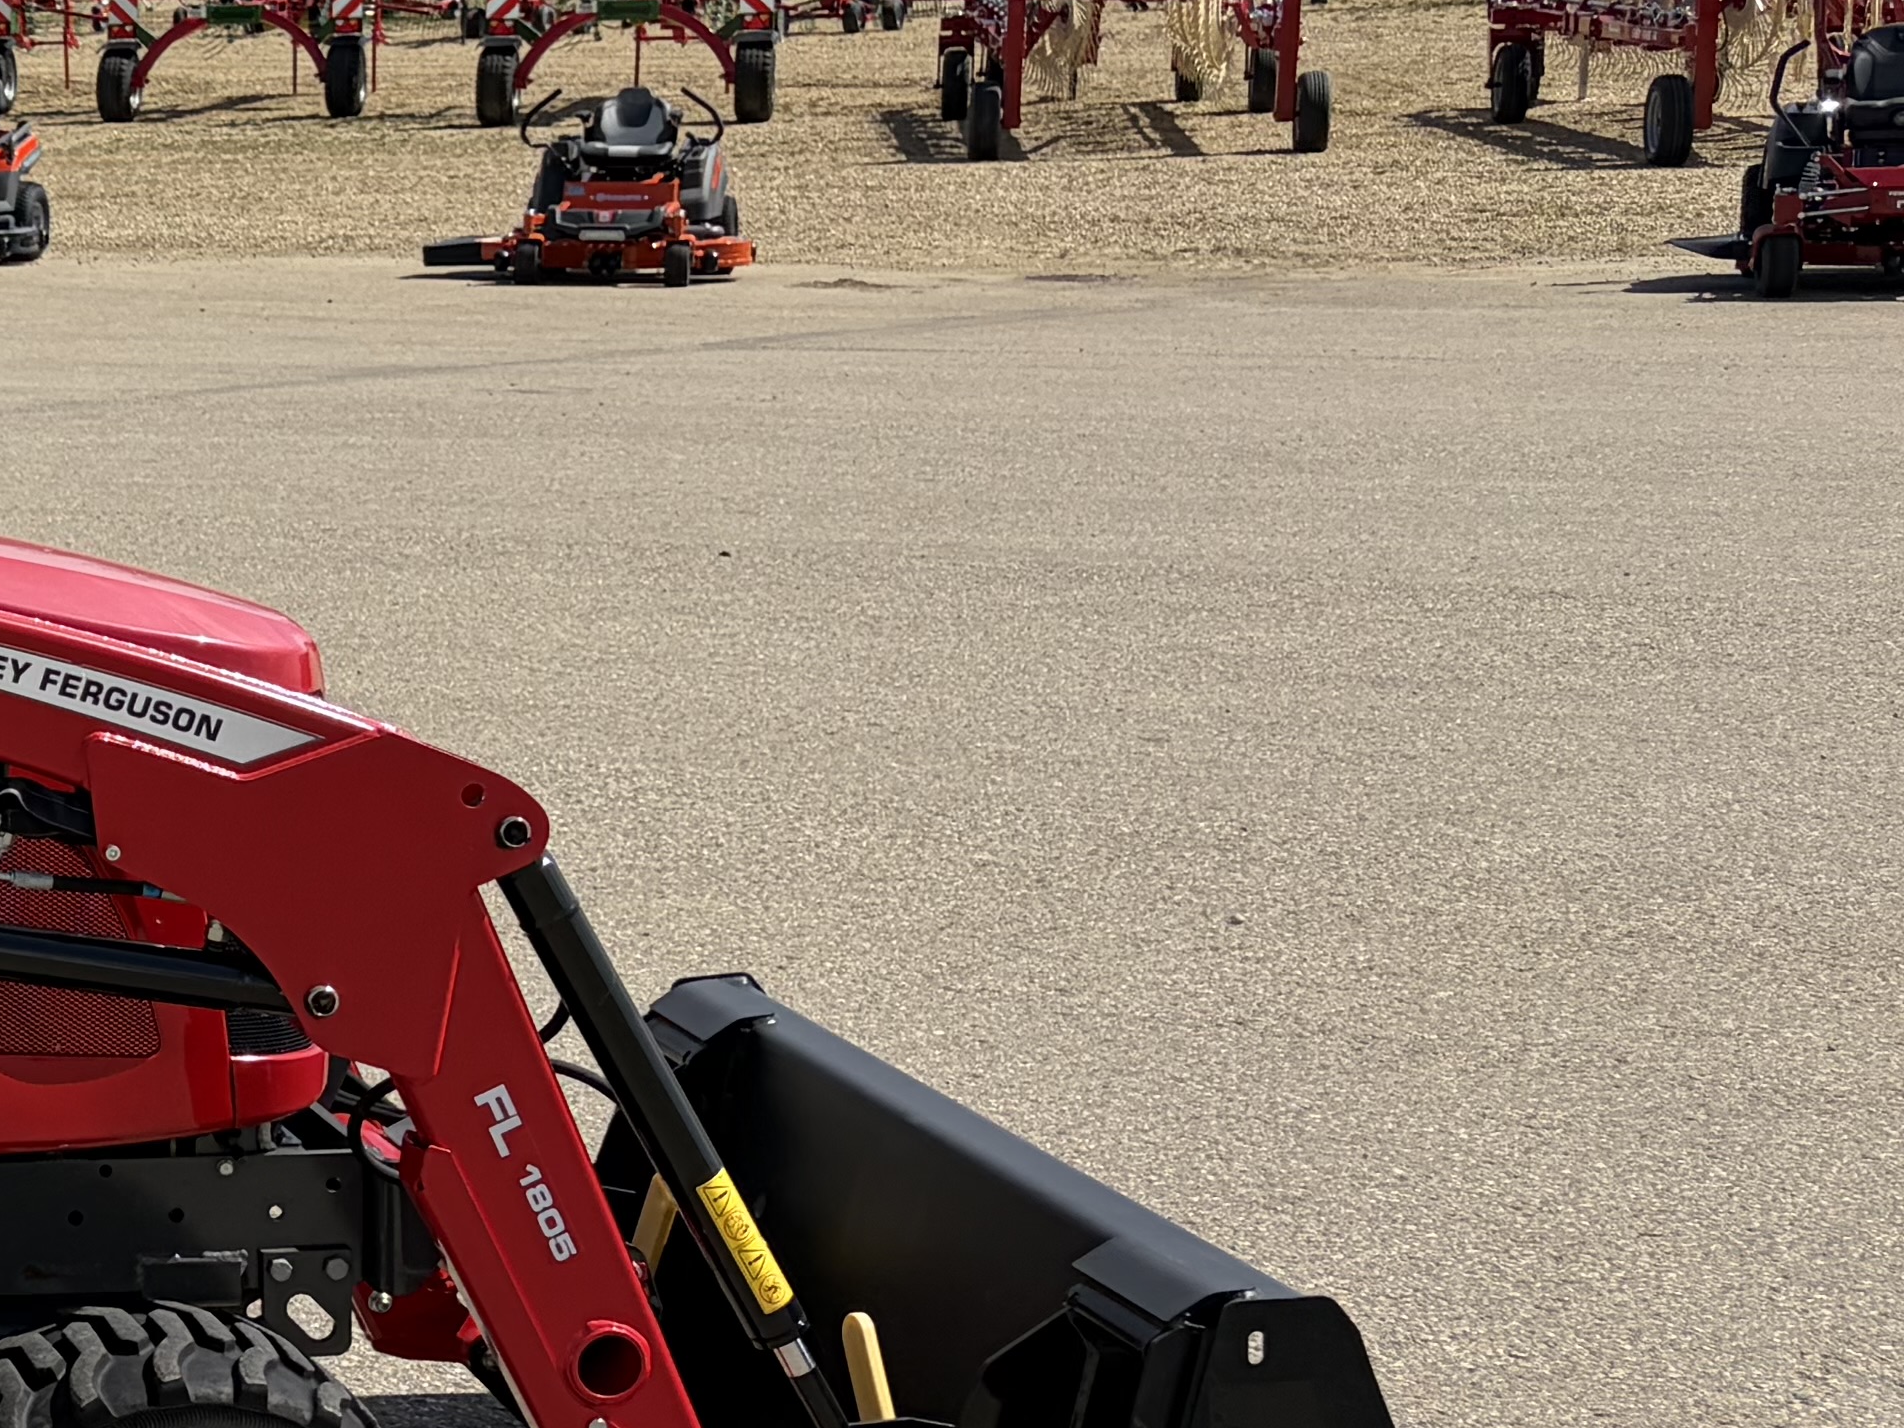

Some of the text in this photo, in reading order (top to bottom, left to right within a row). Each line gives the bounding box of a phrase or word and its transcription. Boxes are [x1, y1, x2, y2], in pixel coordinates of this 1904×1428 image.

[39, 667, 223, 742] FERGUSON
[474, 1084, 577, 1262] FL 1805
